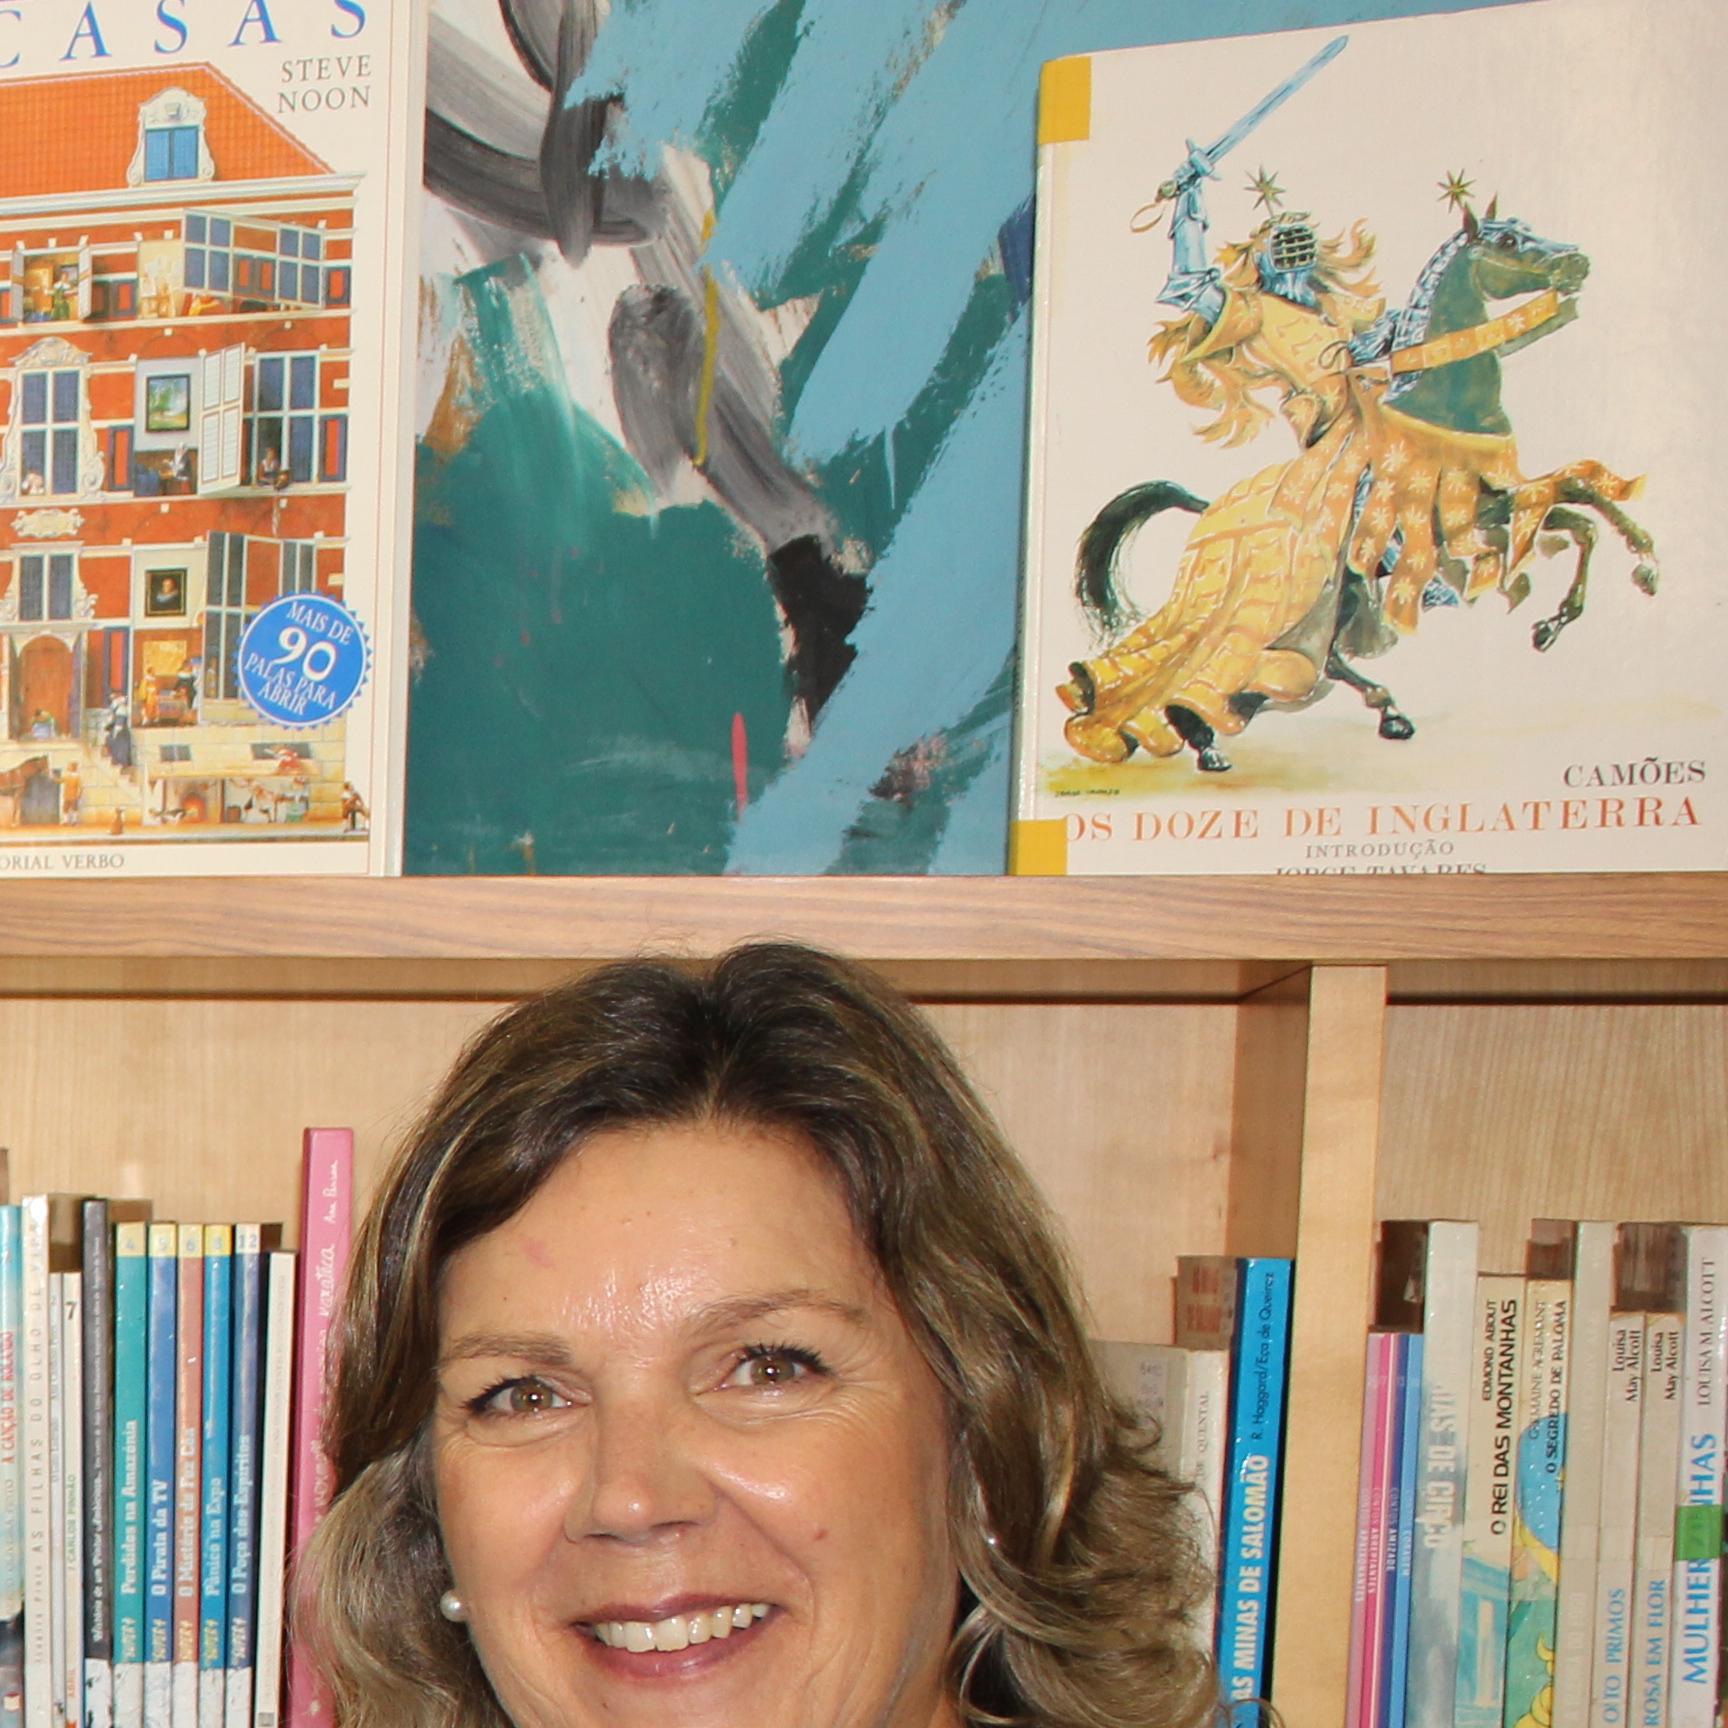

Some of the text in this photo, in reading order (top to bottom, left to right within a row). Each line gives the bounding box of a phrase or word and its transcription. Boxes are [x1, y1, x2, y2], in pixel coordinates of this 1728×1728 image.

[280, 54, 373, 84] STEVE
[277, 85, 372, 115] NOON
[286, 601, 355, 646] MAIS DE
[273, 625, 339, 682] 90
[244, 652, 338, 710] PALAS PARA
[257, 681, 309, 716] ABRIR
[1562, 755, 1708, 790] CAMÕES
[1134, 809, 1259, 842] DOZE
[1283, 806, 1342, 838] DE
[1367, 796, 1702, 837] INGLATERRA
[62, 851, 126, 871] VERBO
[1306, 838, 1455, 860] INTRODUÇÃO
[185, 1238, 195, 1251] 6
[65, 1301, 77, 1321] 7
[1260, 1322, 1271, 1339] de
[1697, 1256, 1715, 1406] LOUISA ALCOTT
[0, 1331, 15, 1381] ROLANDO
[1482, 1300, 1498, 1401] EDMOND ABOUT
[1611, 1329, 1627, 1373] Louisa
[1624, 1329, 1643, 1402] May Alcott
[1649, 1331, 1664, 1373] Louisa
[1664, 1331, 1680, 1401] May Alcott
[0, 1388, 15, 1402] DE
[1545, 1301, 1566, 1474] O SEGREDO DE PALOMA
[0, 1405, 17, 1449] CANÇÃO
[30, 1289, 43, 1552] AS FILHAS DO OLHO DE
[1198, 1390, 1210, 1454] QUENTAL
[1490, 1298, 1517, 1536] O REI DAS MONTANHAS
[178, 1462, 195, 1489] Foz
[1427, 1443, 1457, 1474] DE
[65, 1474, 77, 1516] PINHÃO
[120, 1419, 138, 1595] Perdidos na Amazónia
[228, 1434, 251, 1595] O Poço dos Espíritos
[1240, 1454, 1270, 1560] SALOMÃO
[66, 1518, 77, 1563] CARLOS
[151, 1478, 168, 1596] O Pirata da TV
[178, 1516, 195, 1582] Mistério
[203, 1477, 225, 1596] Pânico na Expo
[1385, 1528, 1398, 1572] AMIZADE
[1240, 1563, 1263, 1595] DE
[1354, 1528, 1369, 1603] APAIXONANTES
[1366, 1527, 1381, 1594] ARREPIANTES
[178, 1587, 195, 1598] O
[1234, 1599, 1261, 1672] MINAS
[1602, 1587, 1626, 1725] OITO PRIMOS
[1642, 1579, 1667, 1728] ROSA EM FLOR
[1230, 1676, 1255, 1701] AS
